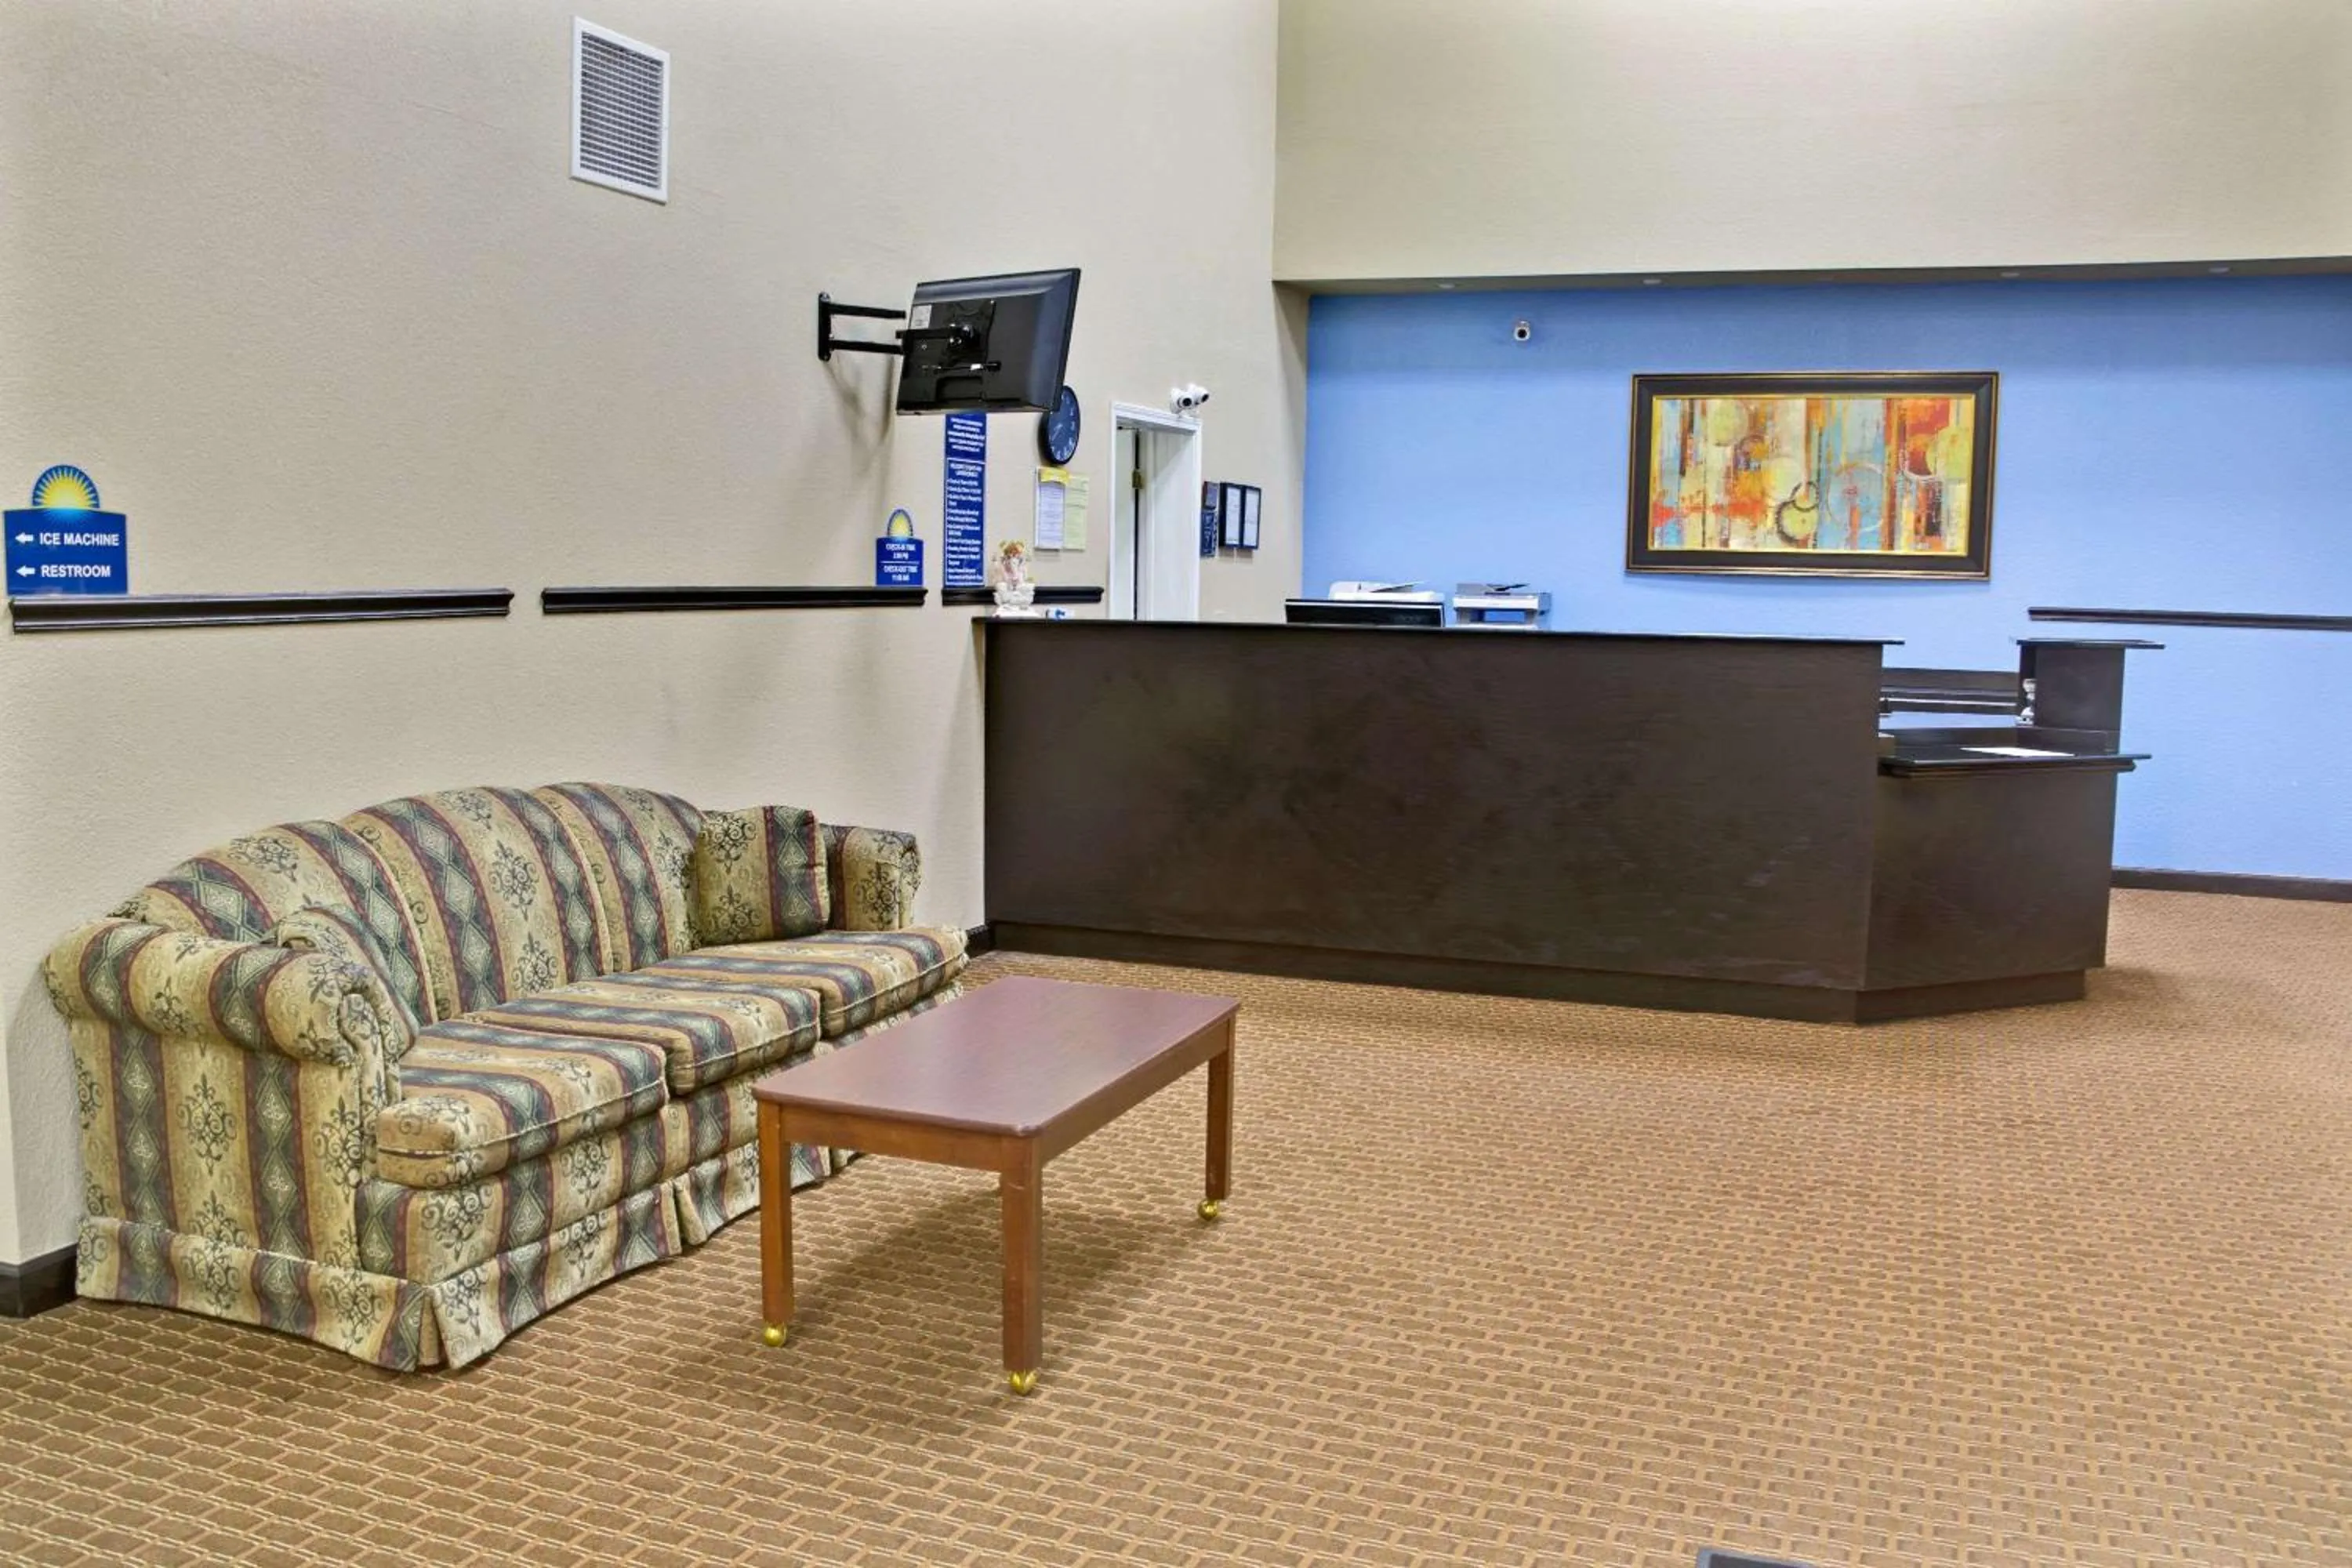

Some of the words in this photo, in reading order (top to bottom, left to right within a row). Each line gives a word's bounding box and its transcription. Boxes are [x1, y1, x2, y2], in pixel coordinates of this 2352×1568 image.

[40, 532, 61, 545] ICE
[64, 533, 119, 546] MACHINE
[41, 564, 111, 578] RESTROOM
